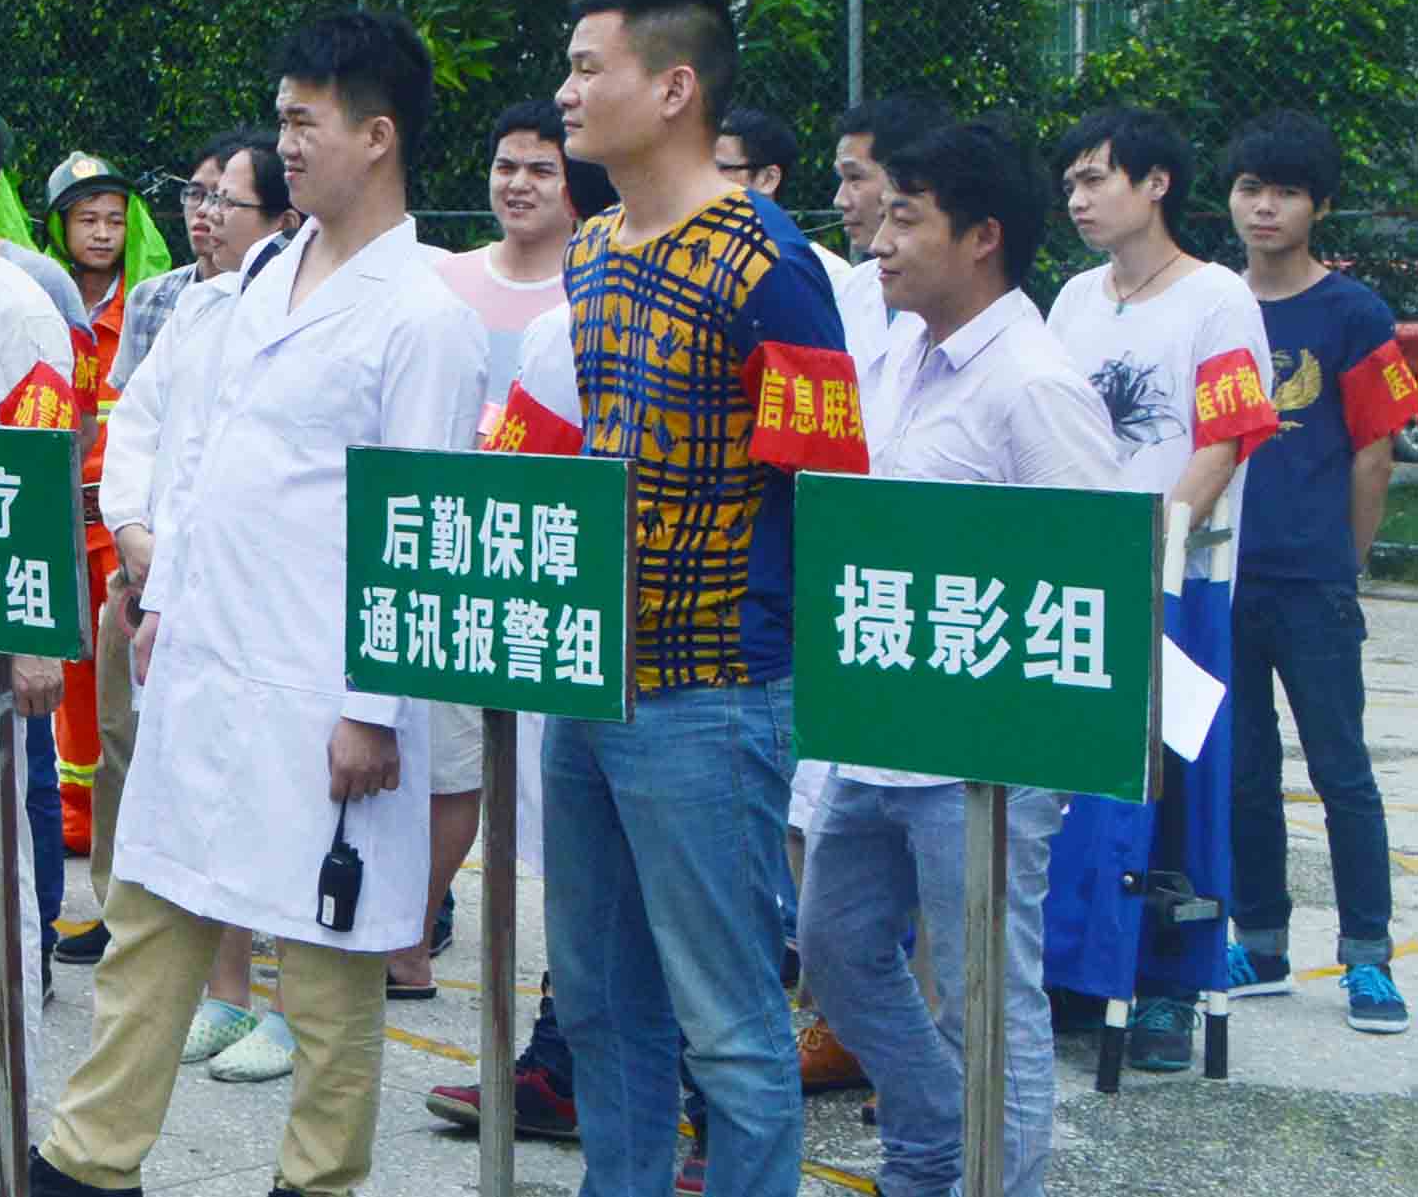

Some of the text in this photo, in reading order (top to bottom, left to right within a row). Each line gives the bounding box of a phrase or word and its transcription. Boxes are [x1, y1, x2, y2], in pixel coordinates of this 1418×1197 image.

[382, 494, 579, 585] 后勤保障
[359, 586, 604, 686] 通讯报警组
[835, 564, 1112, 689] 摄影组
